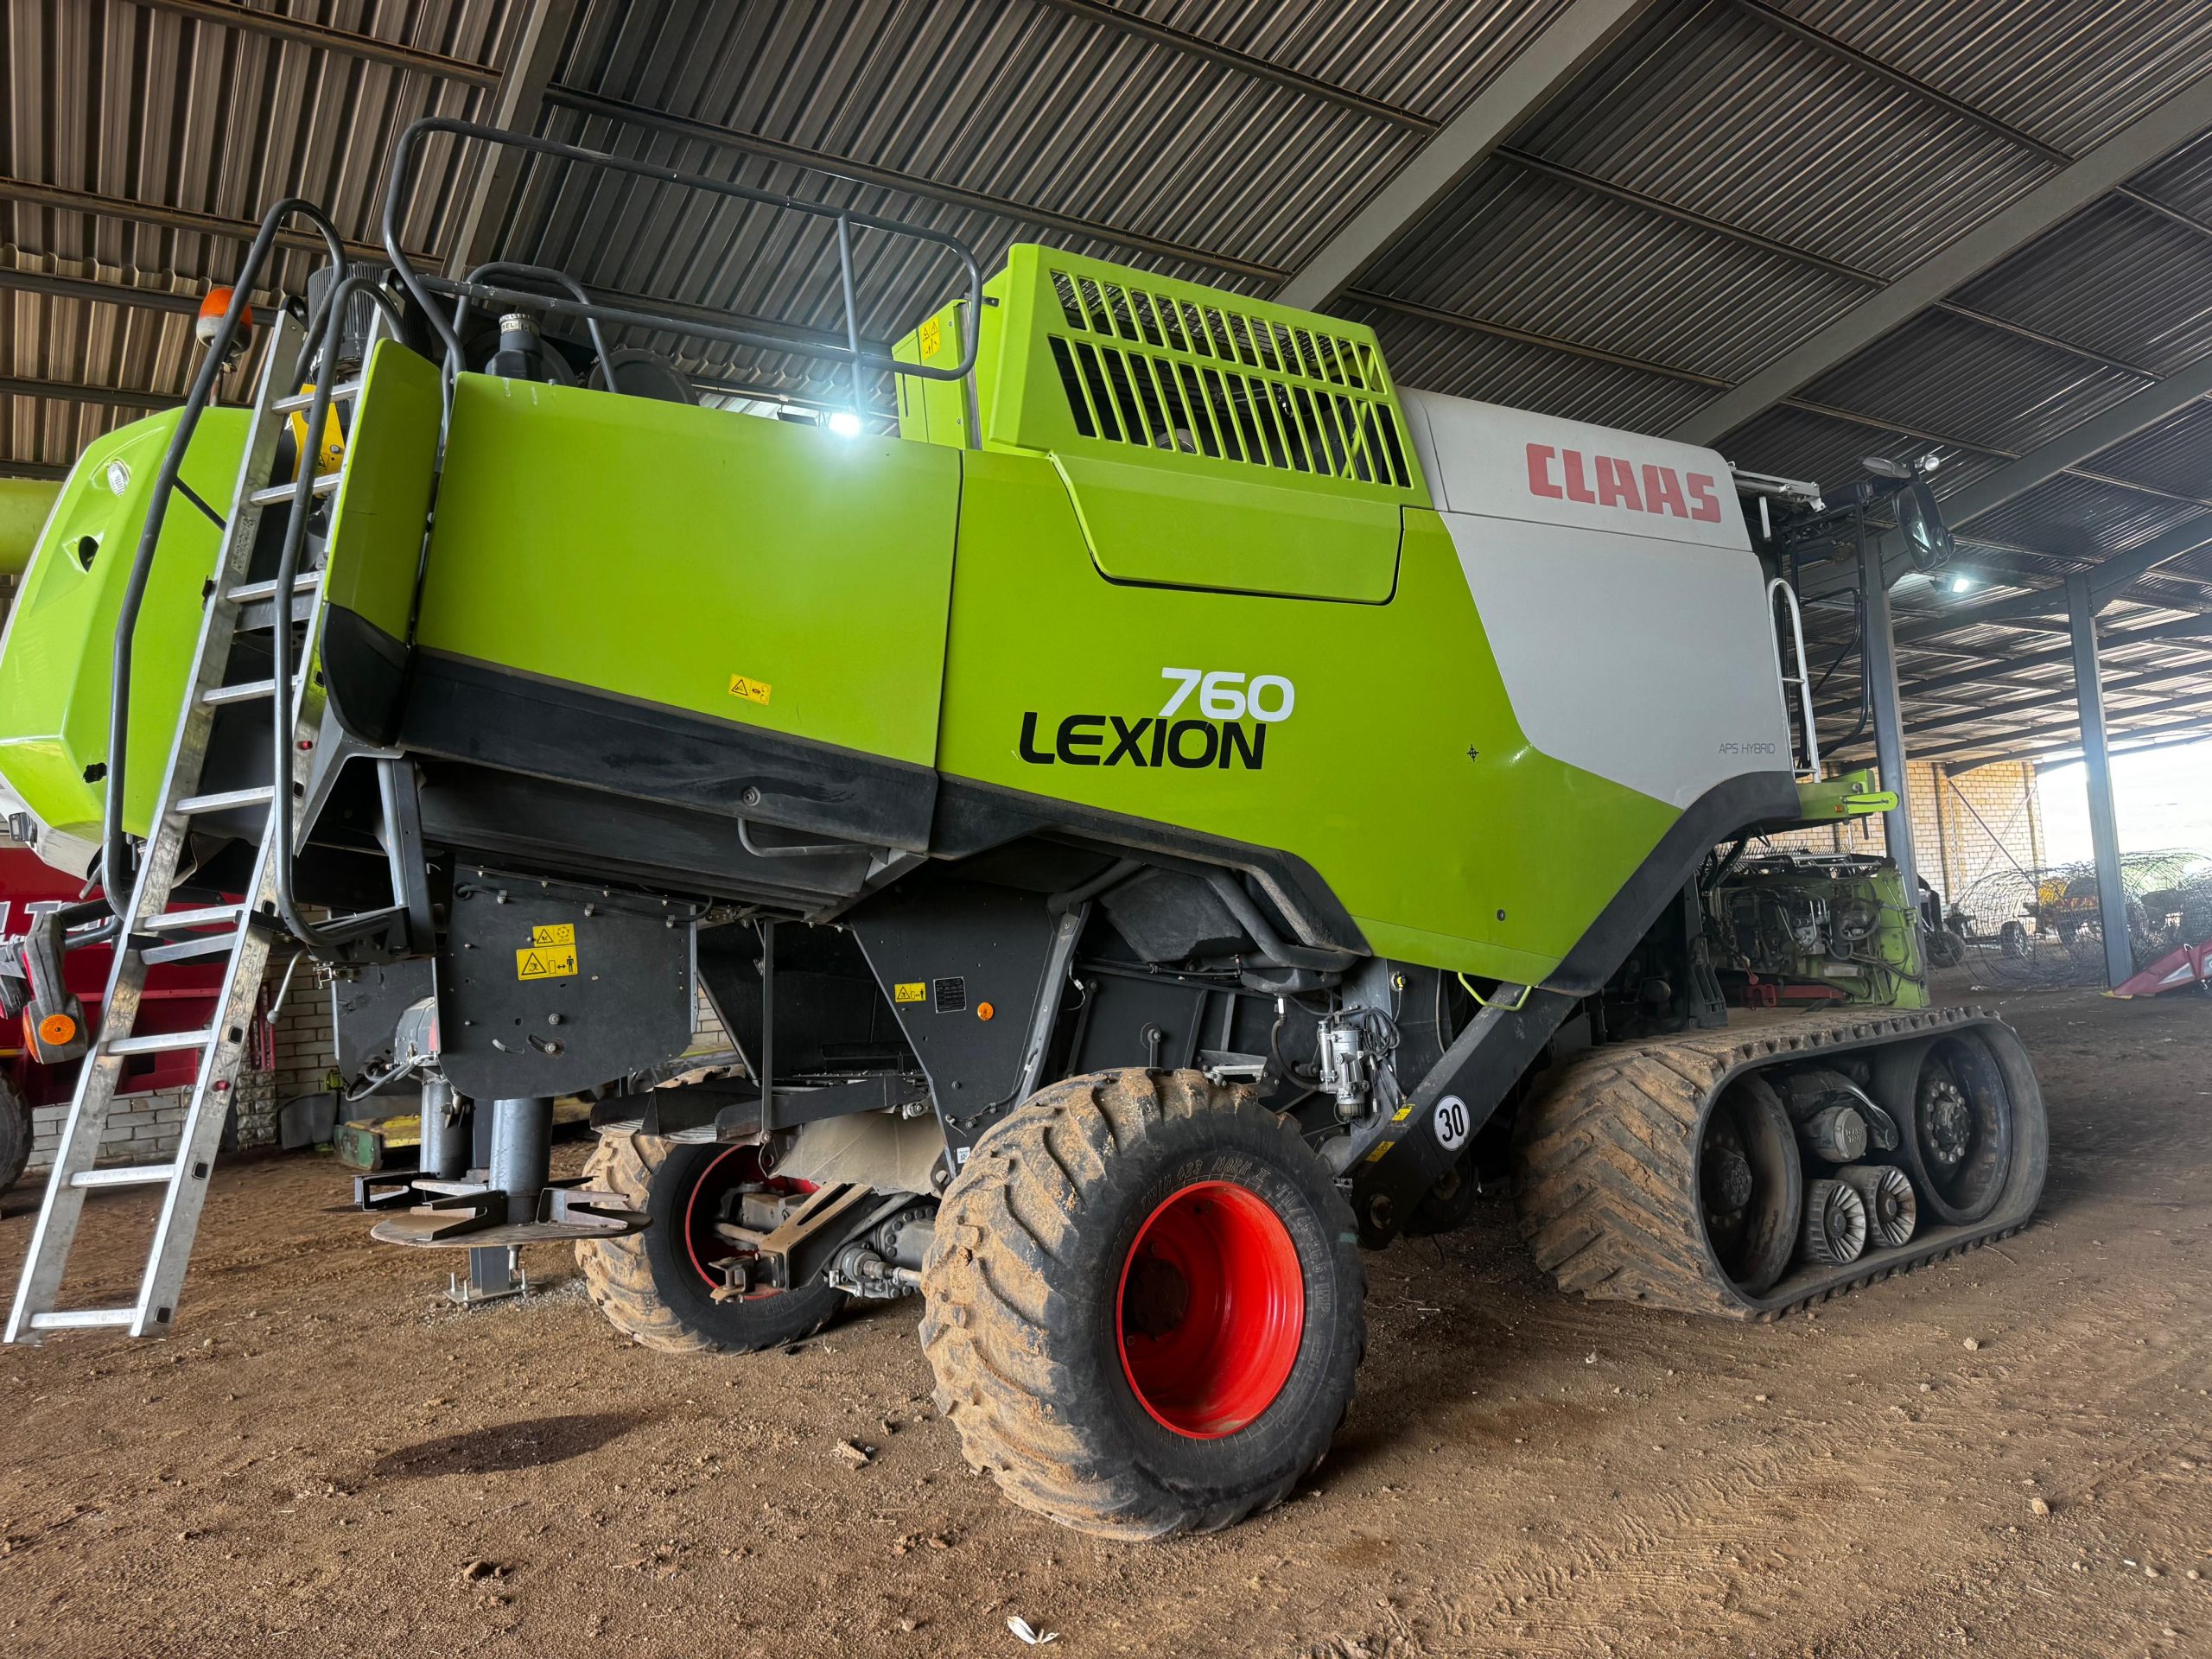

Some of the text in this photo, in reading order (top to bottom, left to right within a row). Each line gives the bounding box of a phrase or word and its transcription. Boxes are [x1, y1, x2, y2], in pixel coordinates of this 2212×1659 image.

[1526, 442, 1721, 524] CLAAS
[1158, 667, 1295, 722] 760
[1019, 711, 1267, 770] LEXION
[1719, 742, 1776, 754] APS HYBRID
[1439, 1103, 1465, 1142] 30
[1211, 1155, 1253, 1175] MARK
